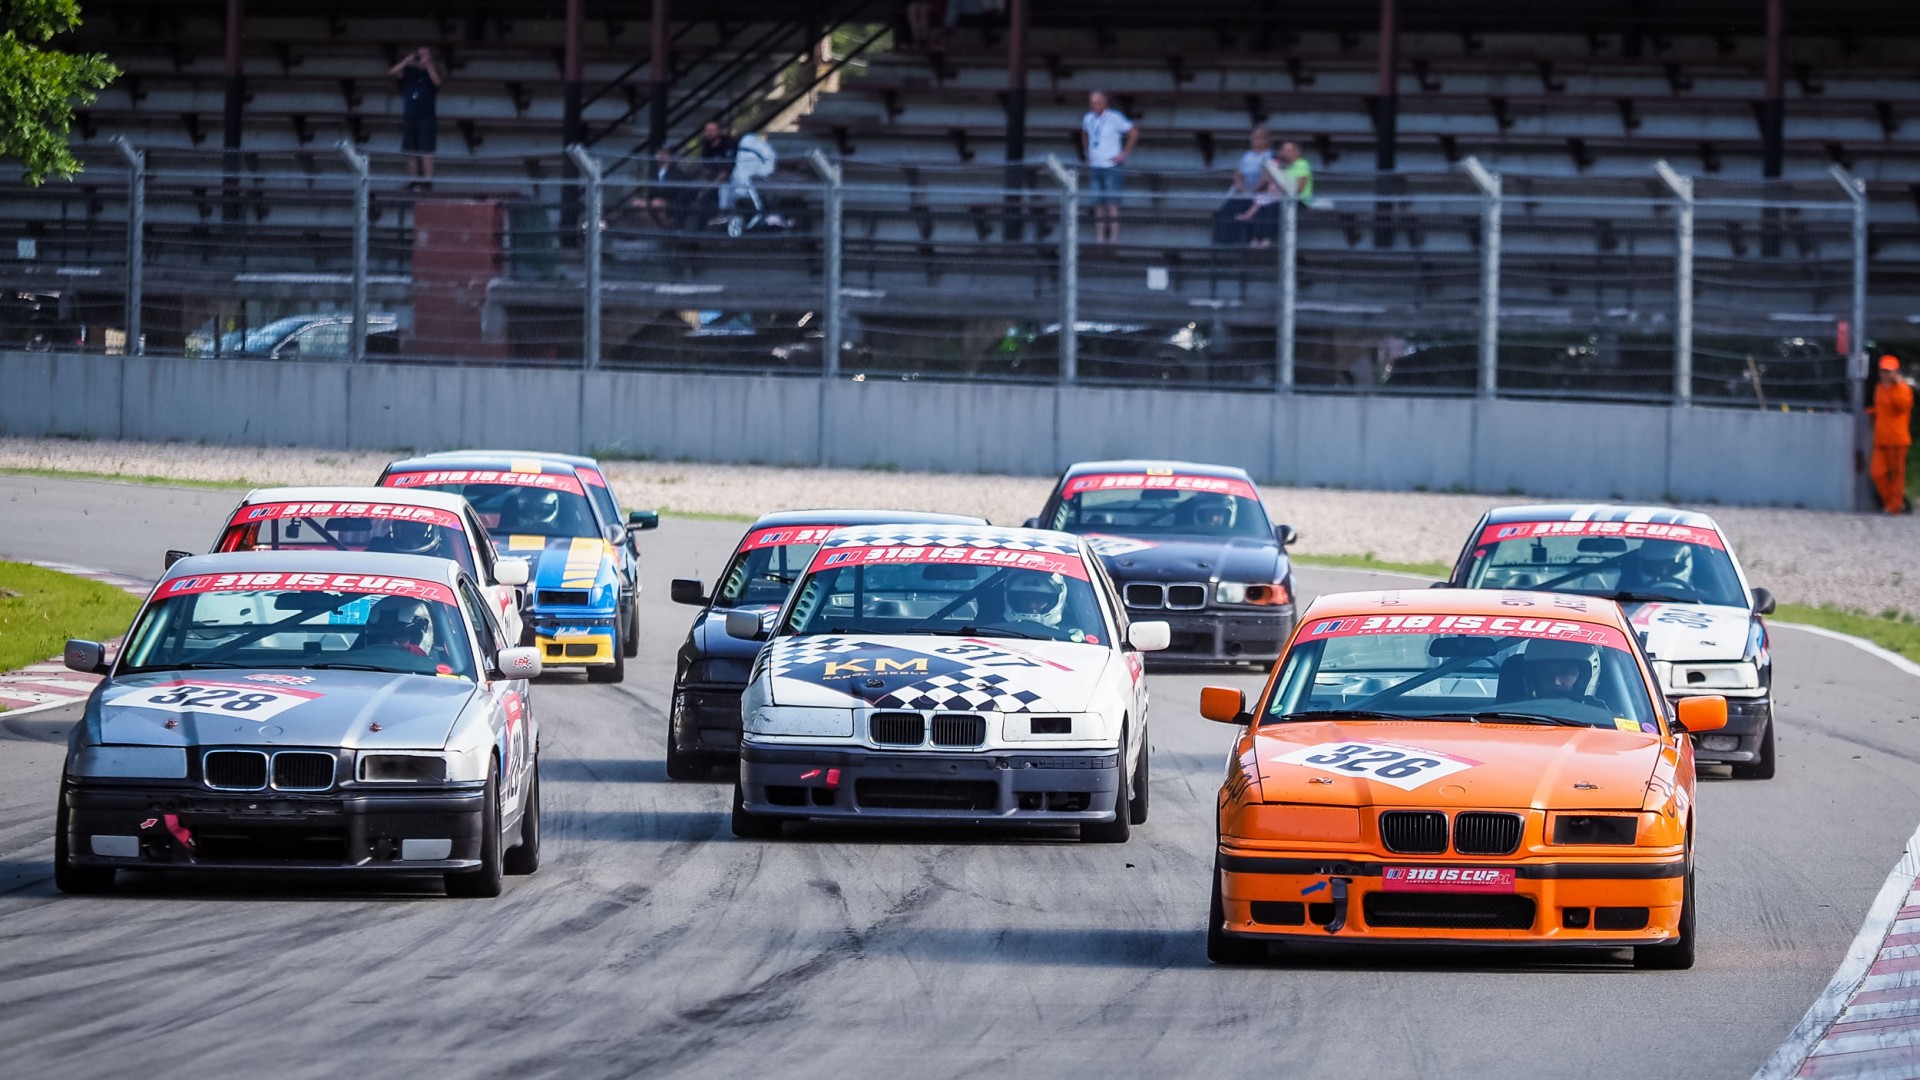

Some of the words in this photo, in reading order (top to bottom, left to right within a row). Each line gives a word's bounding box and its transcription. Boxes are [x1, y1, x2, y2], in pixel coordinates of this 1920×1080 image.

[423, 471, 468, 483] 318
[470, 471, 498, 481] IS
[500, 472, 556, 485] CUP
[1101, 476, 1145, 488] 318
[1146, 476, 1174, 487] IS
[1174, 477, 1229, 489] CUP
[282, 503, 330, 515] 318
[336, 503, 366, 514] IS
[371, 504, 435, 519] CUP
[795, 529, 829, 541] 31
[1532, 522, 1585, 534] 318
[1588, 522, 1622, 533] IS
[1625, 524, 1693, 538] CUP
[864, 547, 926, 560] 318
[928, 547, 968, 559] IS
[970, 548, 1046, 565] CUP
[1026, 560, 1067, 574] PL
[213, 573, 284, 587] 318
[284, 573, 330, 586] IS
[331, 574, 416, 590] CUP
[395, 584, 440, 600] PL
[1360, 616, 1435, 630] 318
[1438, 616, 1487, 629] IS
[1489, 617, 1581, 634] CUP
[1560, 628, 1609, 645] PL
[935, 644, 1042, 667] 317
[823, 657, 930, 676] KM
[148, 686, 279, 712] 328
[1305, 744, 1441, 779] 326
[1407, 869, 1438, 880] 318
[1440, 869, 1460, 880] IS
[1461, 870, 1500, 881] CUP
[1490, 873, 1511, 885] PL
